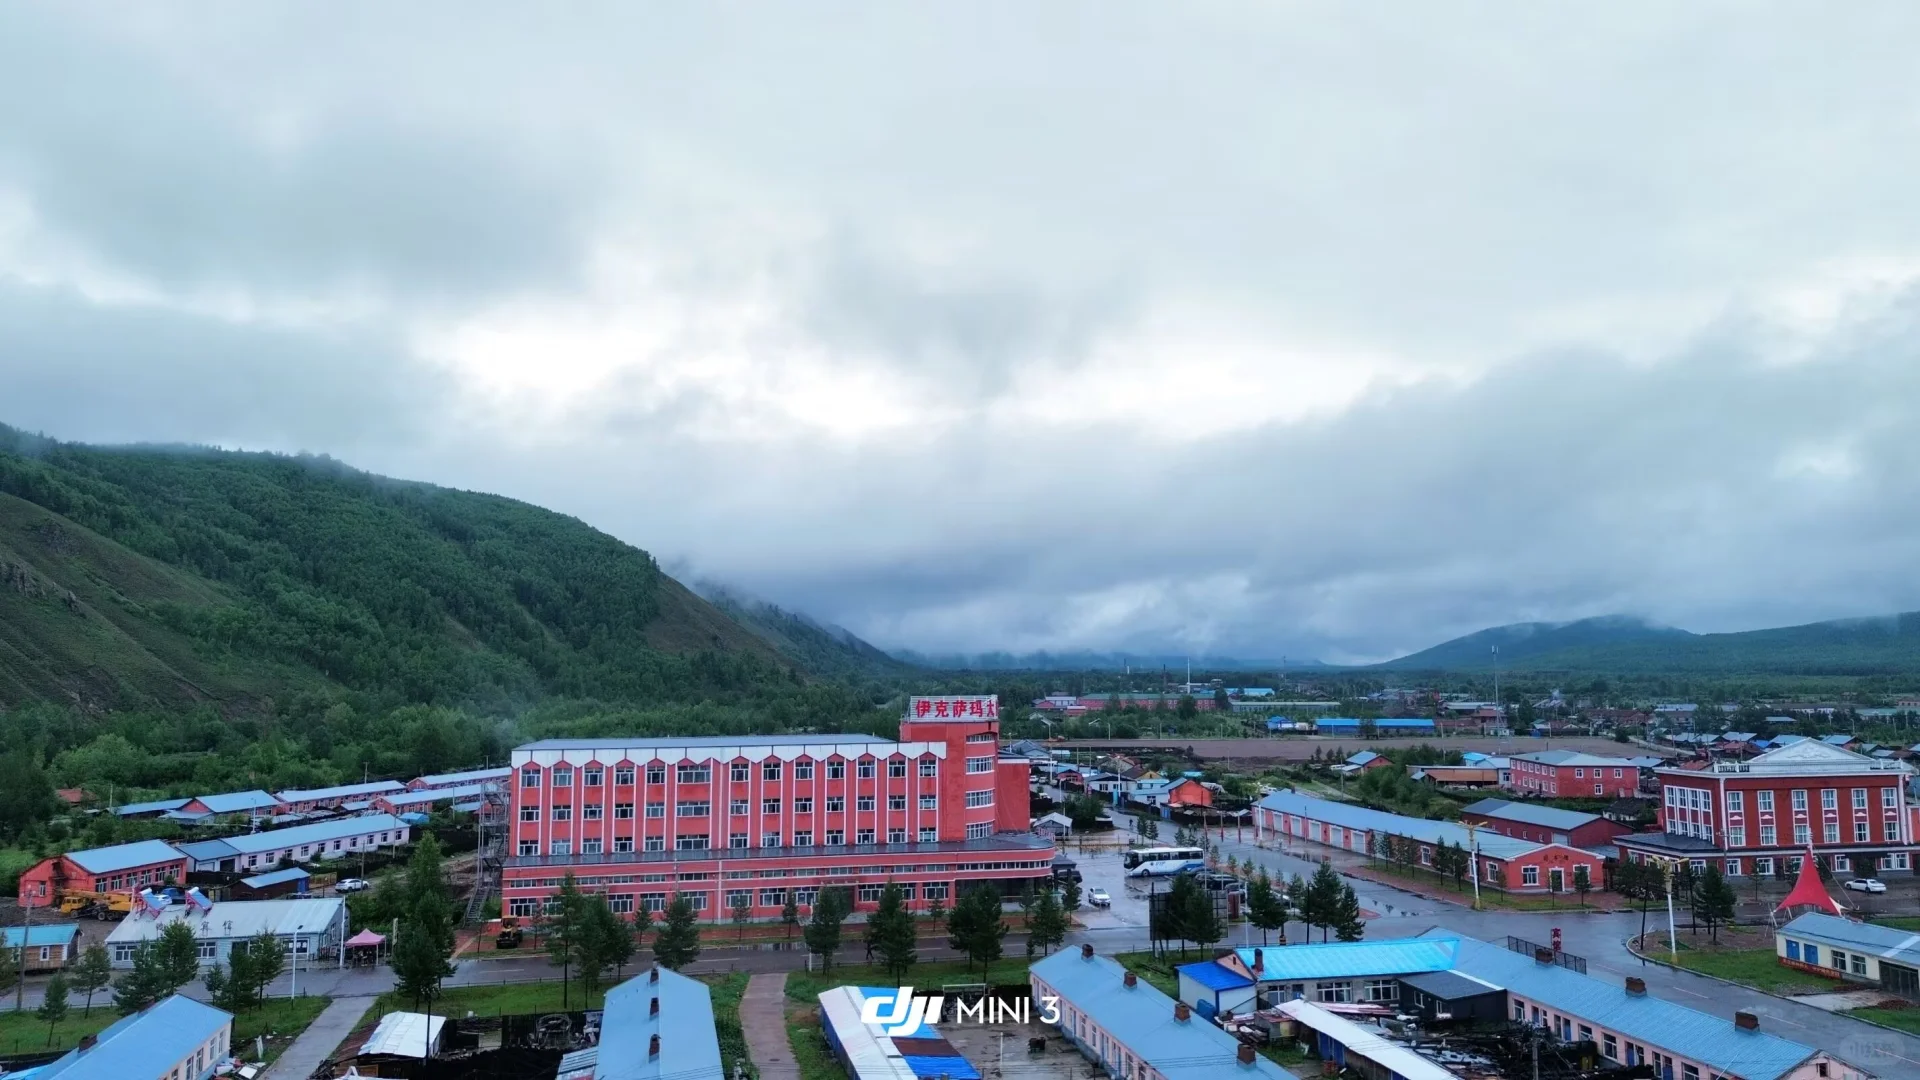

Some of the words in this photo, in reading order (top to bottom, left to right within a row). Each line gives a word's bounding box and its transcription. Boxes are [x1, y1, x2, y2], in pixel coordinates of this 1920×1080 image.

[915, 700, 998, 717] 伊克萨玛大
